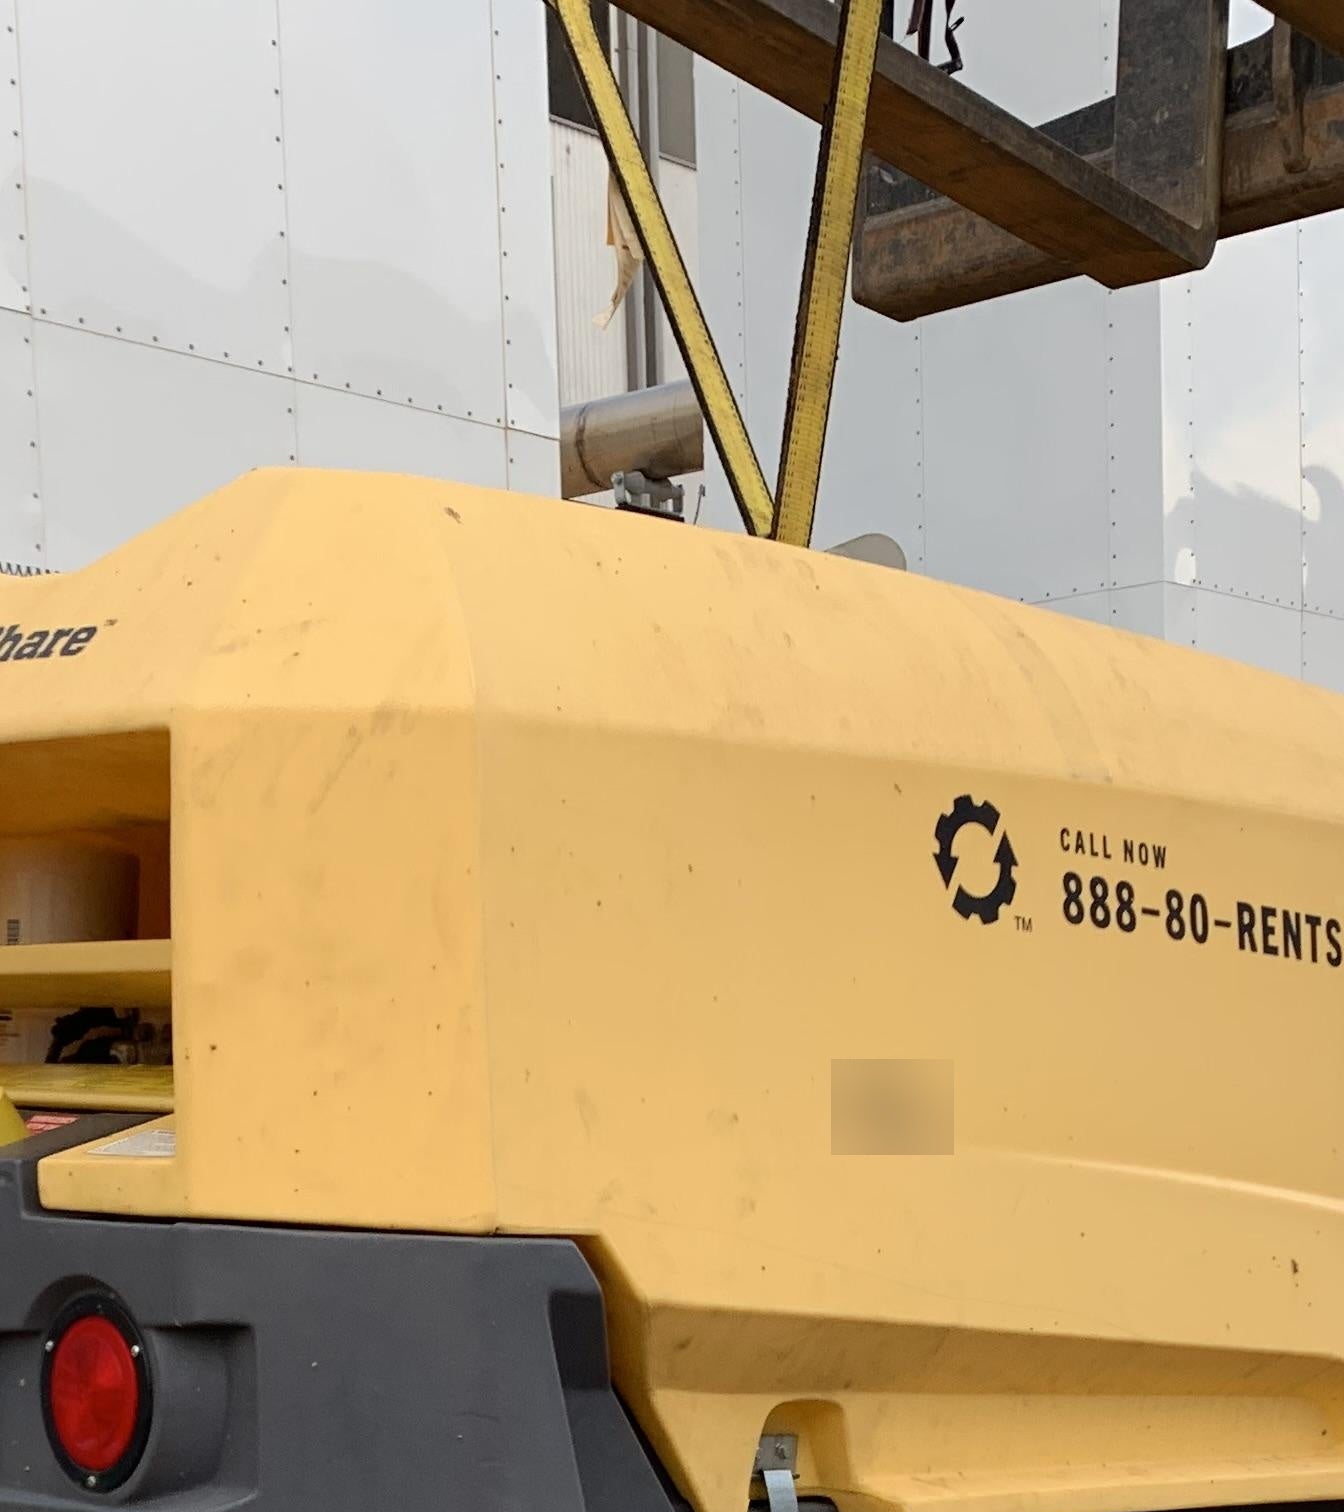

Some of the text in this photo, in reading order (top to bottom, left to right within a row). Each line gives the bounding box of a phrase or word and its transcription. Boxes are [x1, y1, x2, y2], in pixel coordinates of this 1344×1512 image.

[1059, 827, 1167, 869] CALL NOW
[1062, 870, 1344, 967] 888-80-RENTS
